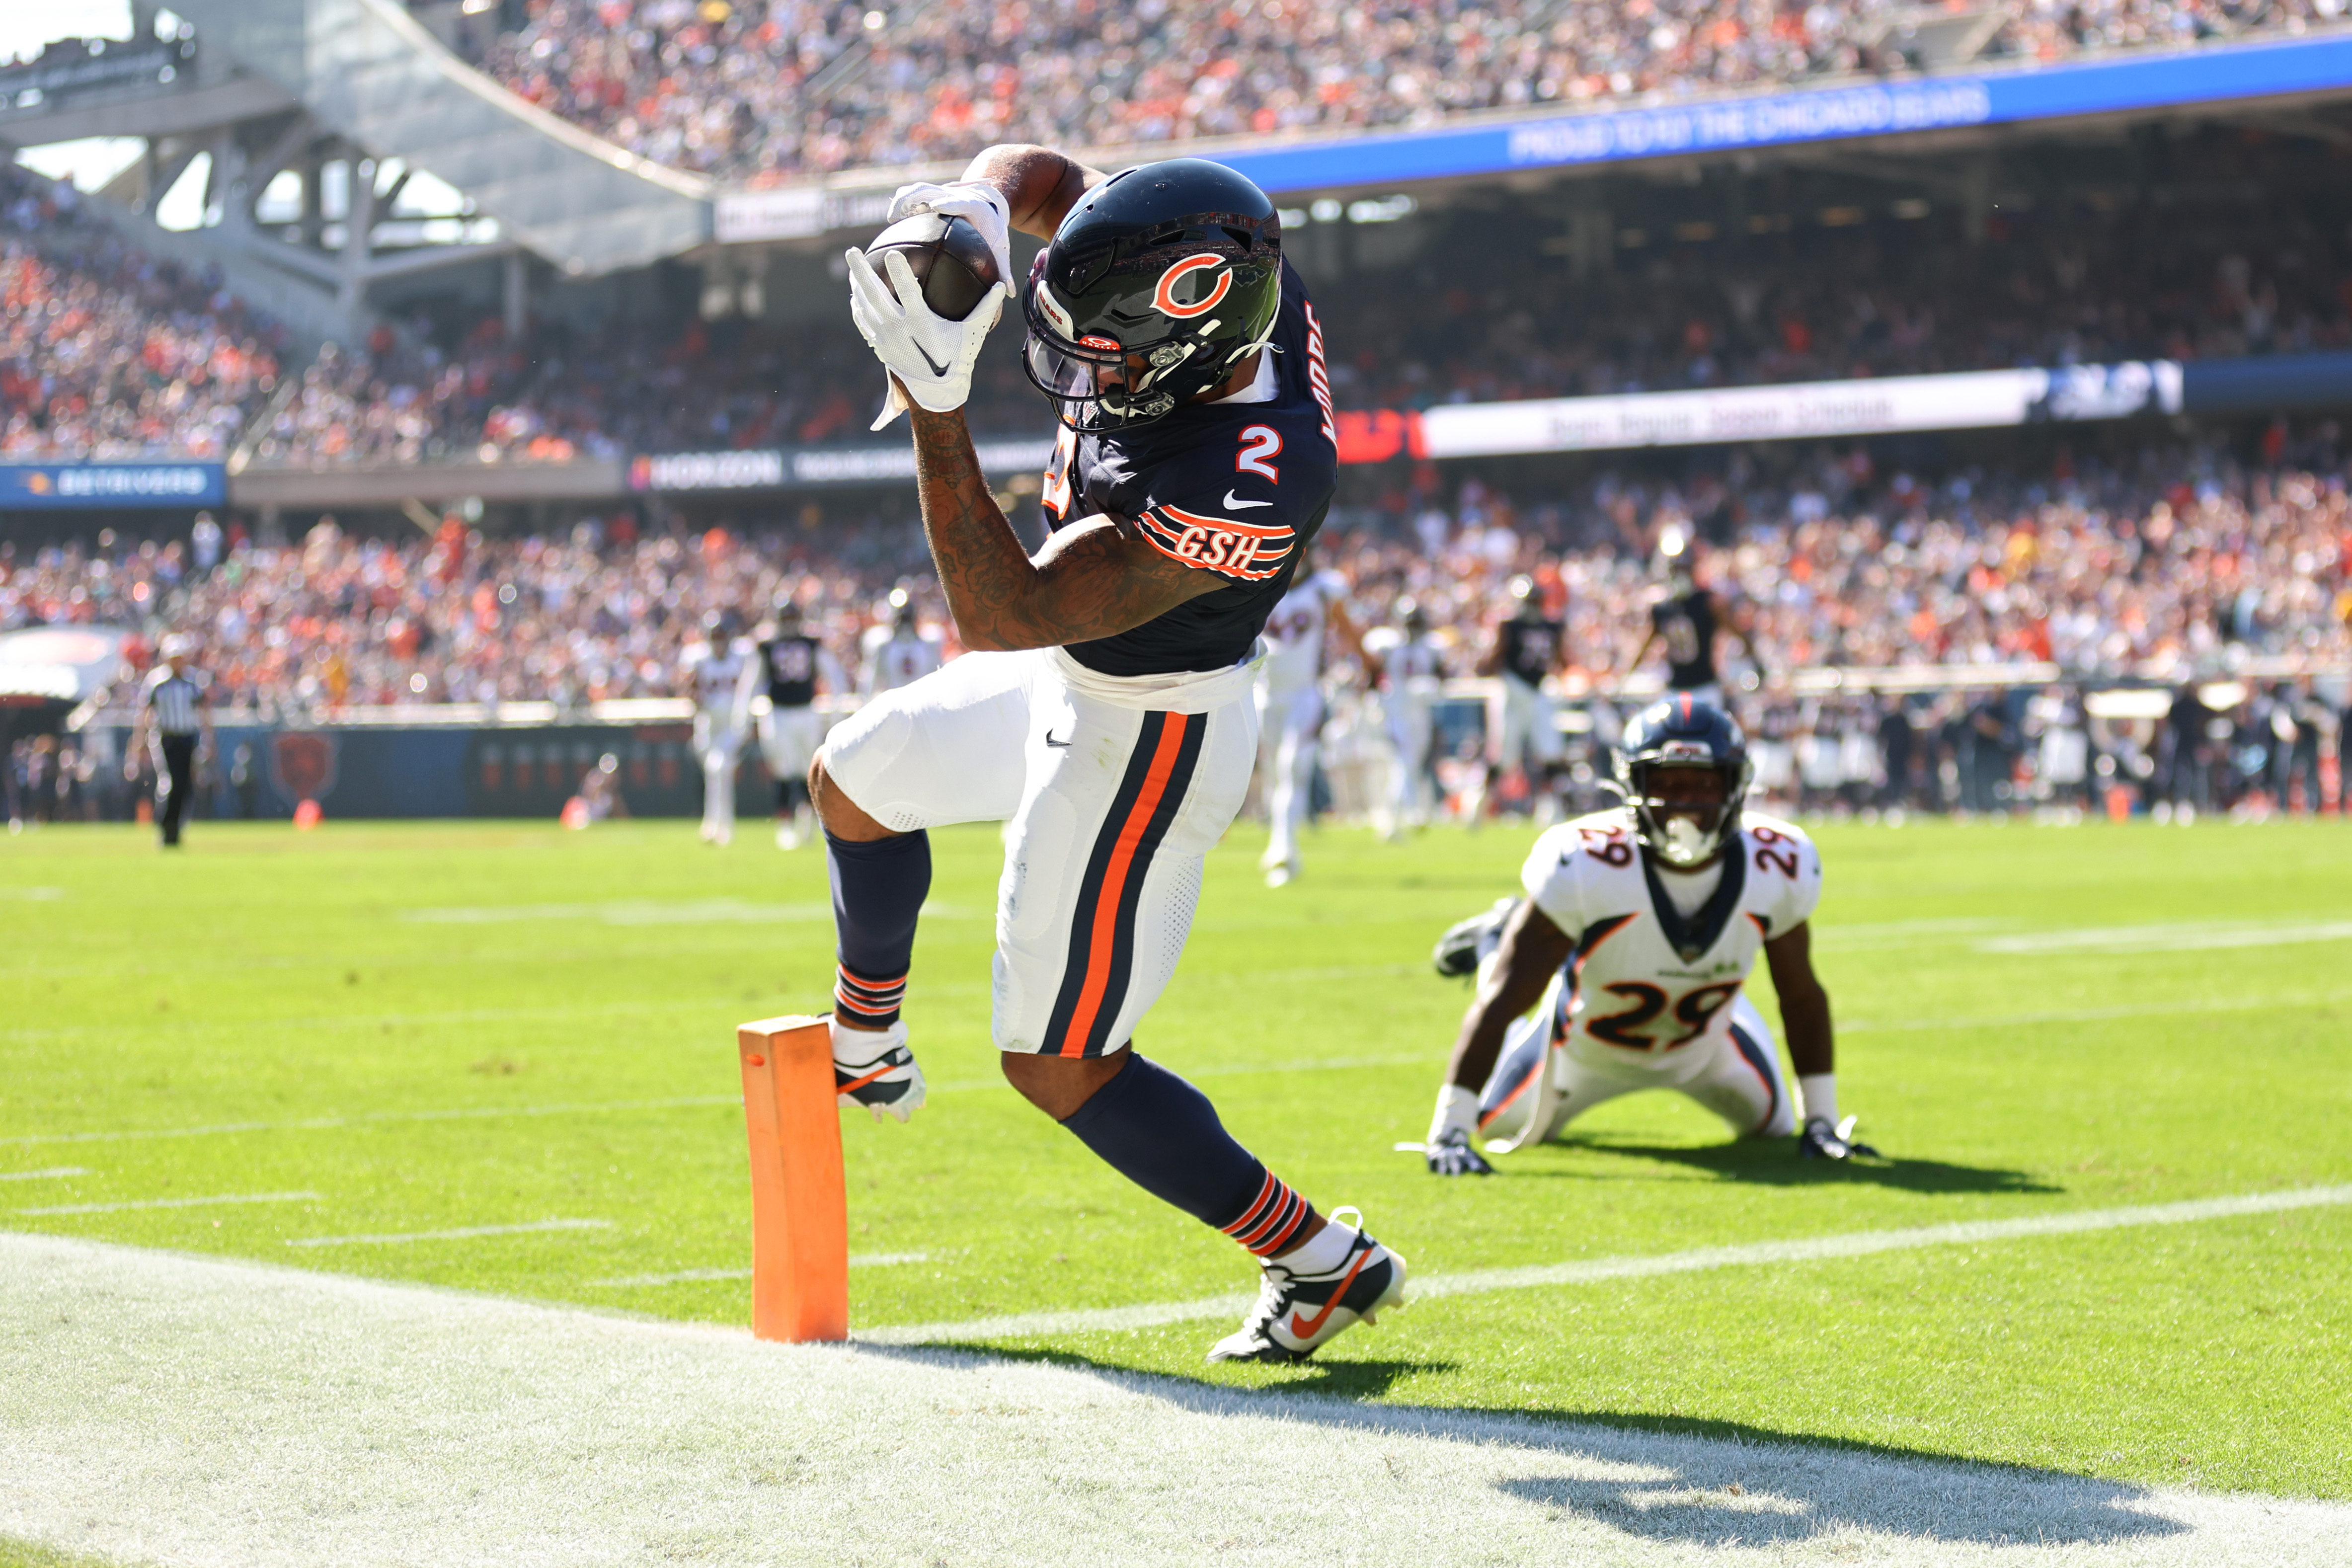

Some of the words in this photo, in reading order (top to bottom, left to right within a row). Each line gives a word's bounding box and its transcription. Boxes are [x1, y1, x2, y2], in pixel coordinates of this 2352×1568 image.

[1507, 120, 1614, 162] PROUD
[1693, 106, 1747, 144] THE
[1039, 290, 1063, 325] BEARS
[1082, 340, 1117, 350] OAKLEY
[1236, 424, 1282, 485] 2
[58, 468, 208, 496] BETRIVERS
[1175, 525, 1262, 570] GSH
[1752, 826, 1799, 881] 29
[1585, 980, 1742, 1053] 29
